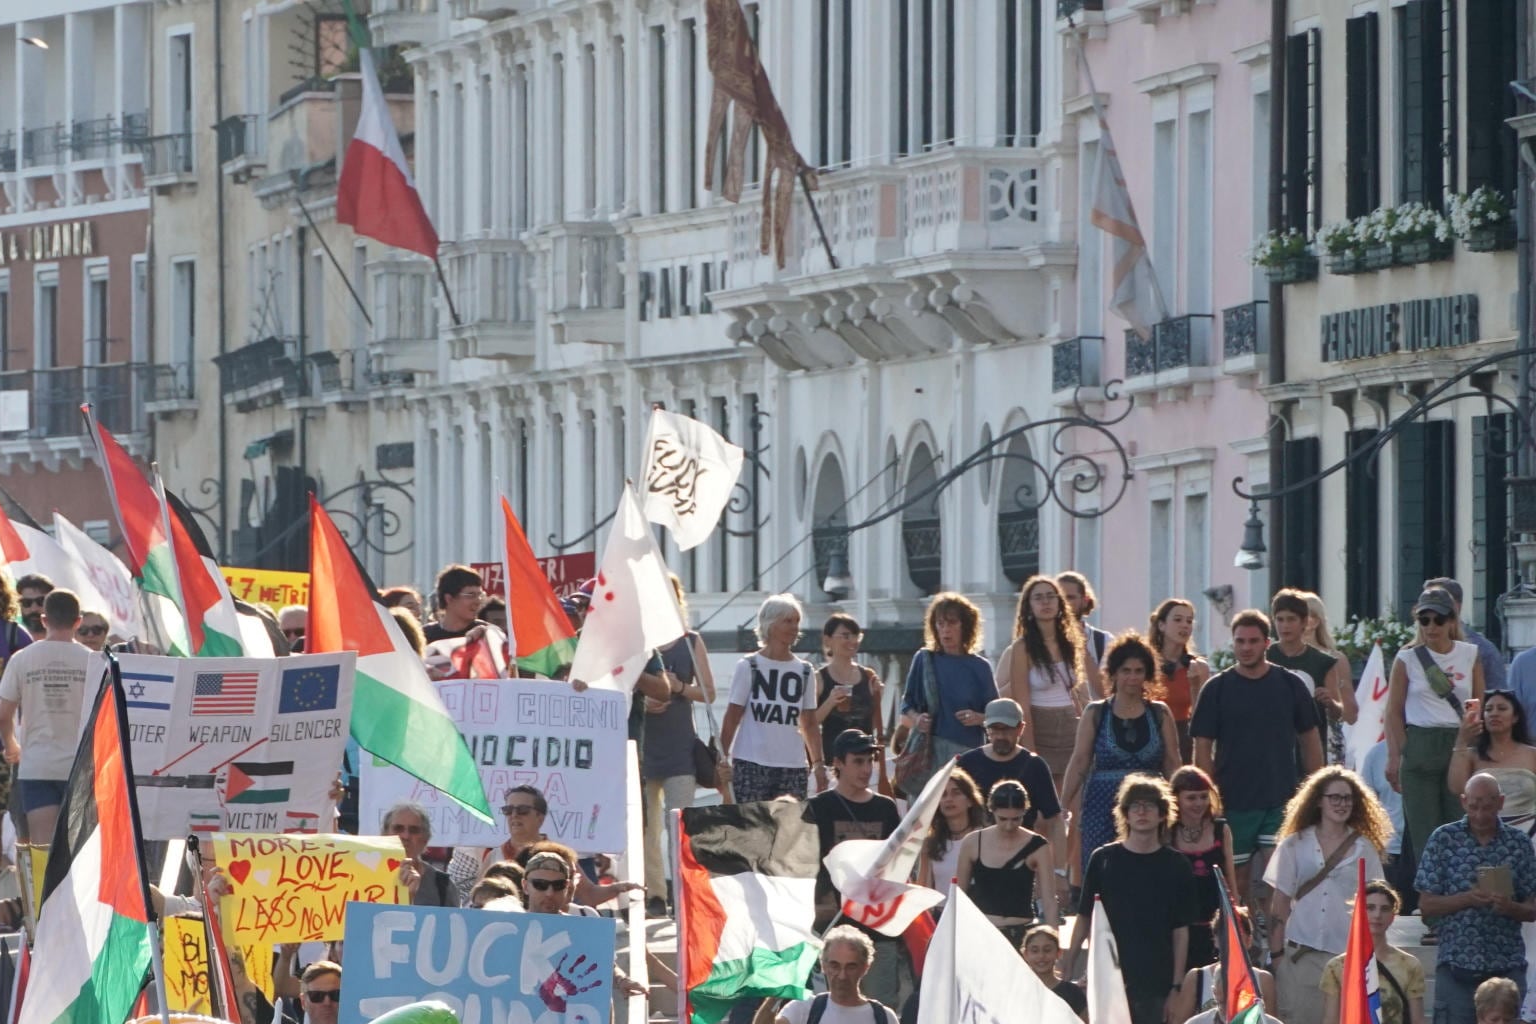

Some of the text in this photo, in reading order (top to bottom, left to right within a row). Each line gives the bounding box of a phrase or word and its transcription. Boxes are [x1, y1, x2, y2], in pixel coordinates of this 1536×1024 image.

[1320, 293, 1478, 362] PENSIONE WILDNER
[751, 669, 802, 703] NO
[517, 692, 618, 730] GIORNI
[750, 702, 800, 726] WAR
[129, 718, 342, 743] OTER WEAPON SILENCER
[479, 769, 569, 806] AZA
[226, 812, 277, 830] VICTIM
[371, 911, 573, 995] FUCK
